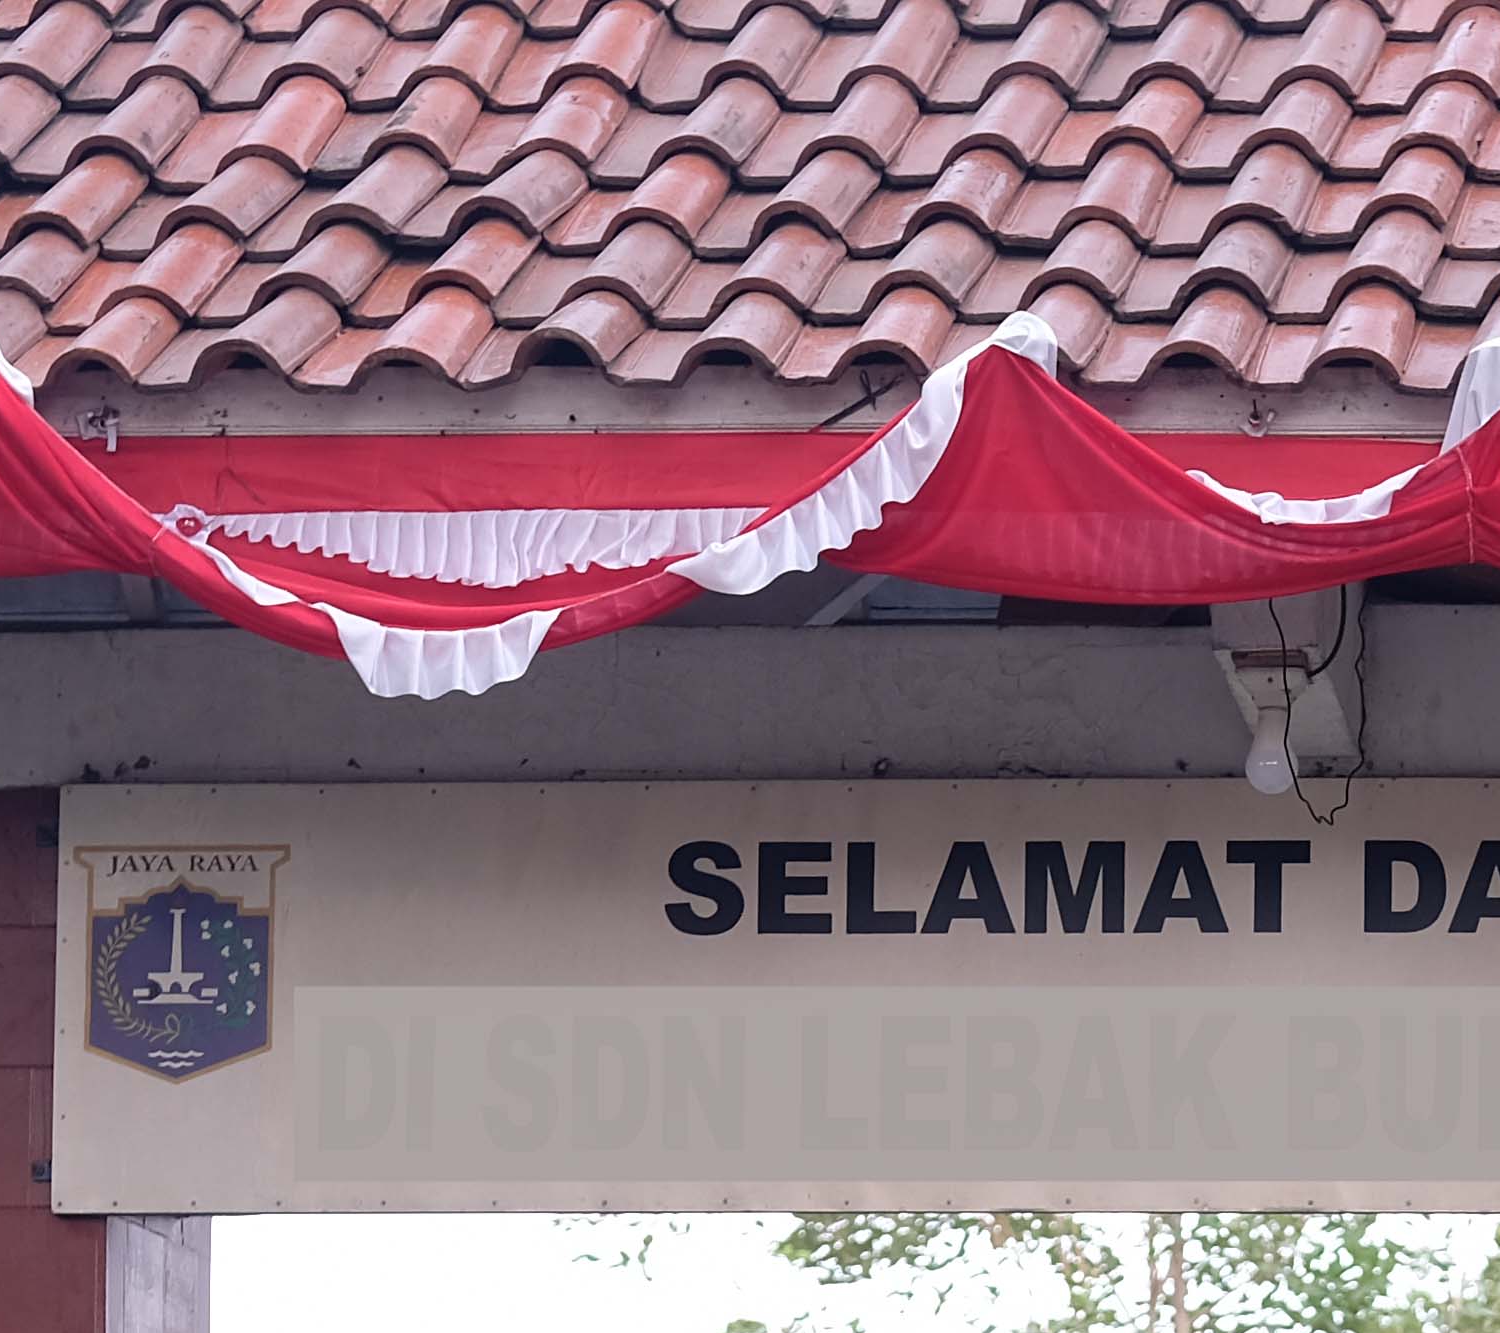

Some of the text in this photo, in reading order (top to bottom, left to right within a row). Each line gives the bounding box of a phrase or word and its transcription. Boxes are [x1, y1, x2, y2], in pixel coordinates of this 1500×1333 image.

[106, 852, 259, 877] JAYA RAYA
[665, 842, 1309, 935] SELAMAT
